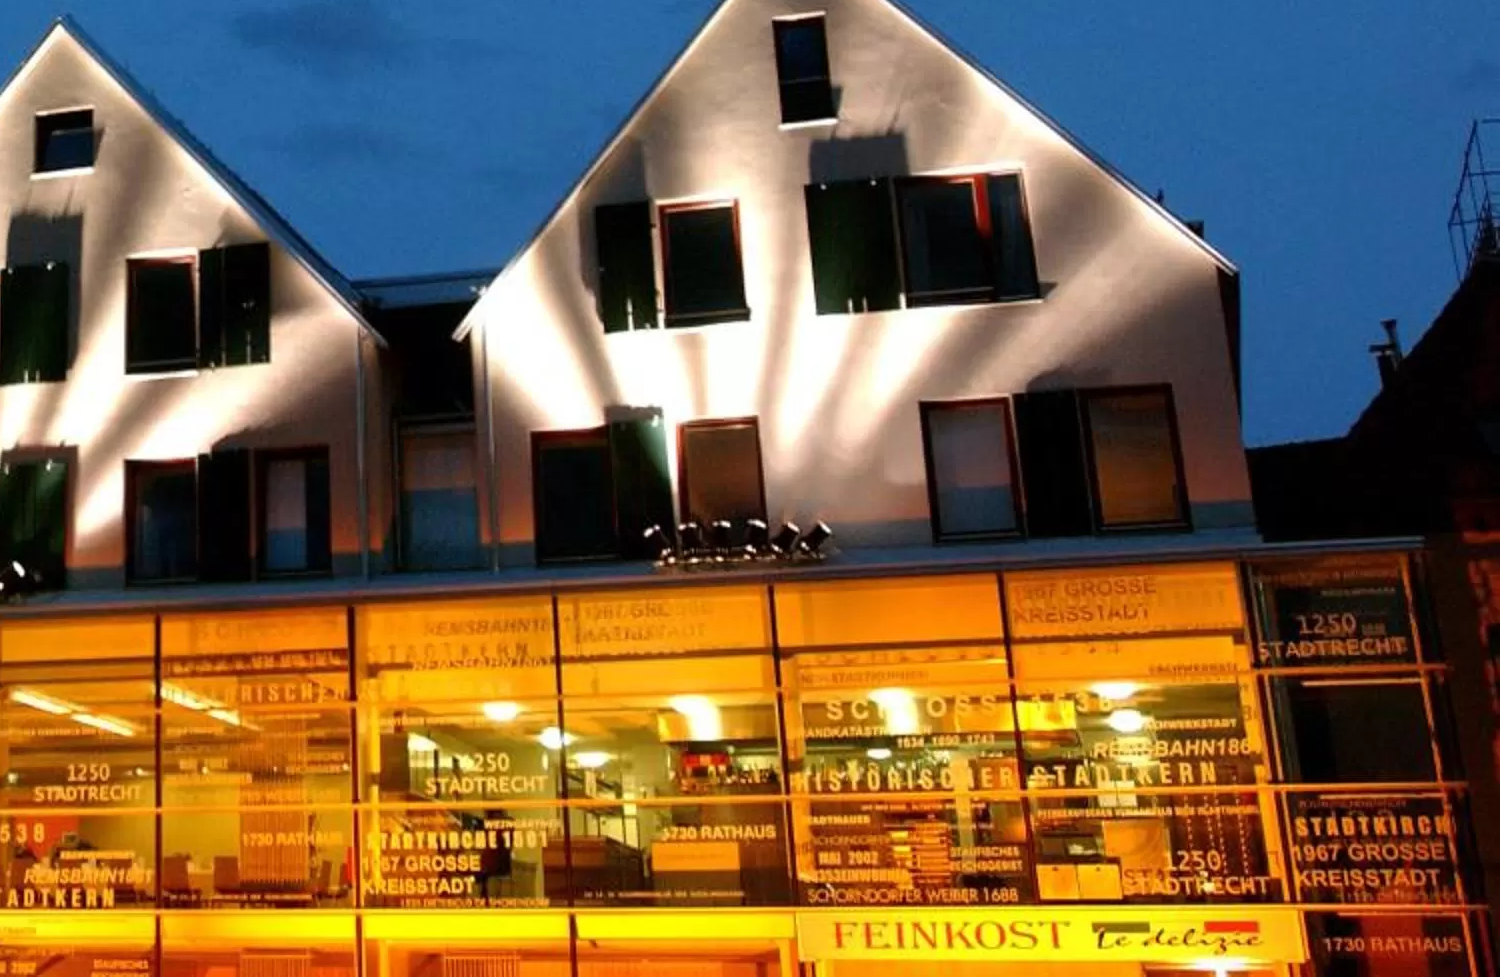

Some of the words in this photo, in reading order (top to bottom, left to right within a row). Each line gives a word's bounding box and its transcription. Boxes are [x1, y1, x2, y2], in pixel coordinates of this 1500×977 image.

[1295, 613, 1357, 635] 1250
[1258, 636, 1407, 660] STADTRECHT
[826, 695, 997, 720] SCOSS
[67, 763, 111, 782] 1250
[34, 785, 142, 802] STADTRECHT
[425, 775, 548, 796] STADTRECHT
[701, 824, 777, 840] RATHAUS
[1293, 844, 1340, 862] 1967
[1348, 842, 1447, 861] GROSSE
[405, 854, 482, 872] GROSSE
[362, 875, 476, 896] KREISSTADT
[1122, 876, 1270, 896] STADTRECHT
[1299, 868, 1441, 888] KREISSTADT
[807, 887, 924, 903] SCHORNDORFER
[834, 920, 1071, 950] FEINKOST
[1142, 927, 1264, 955] delizie
[1323, 937, 1365, 952] 1730
[1371, 937, 1463, 952] RATHAUS
